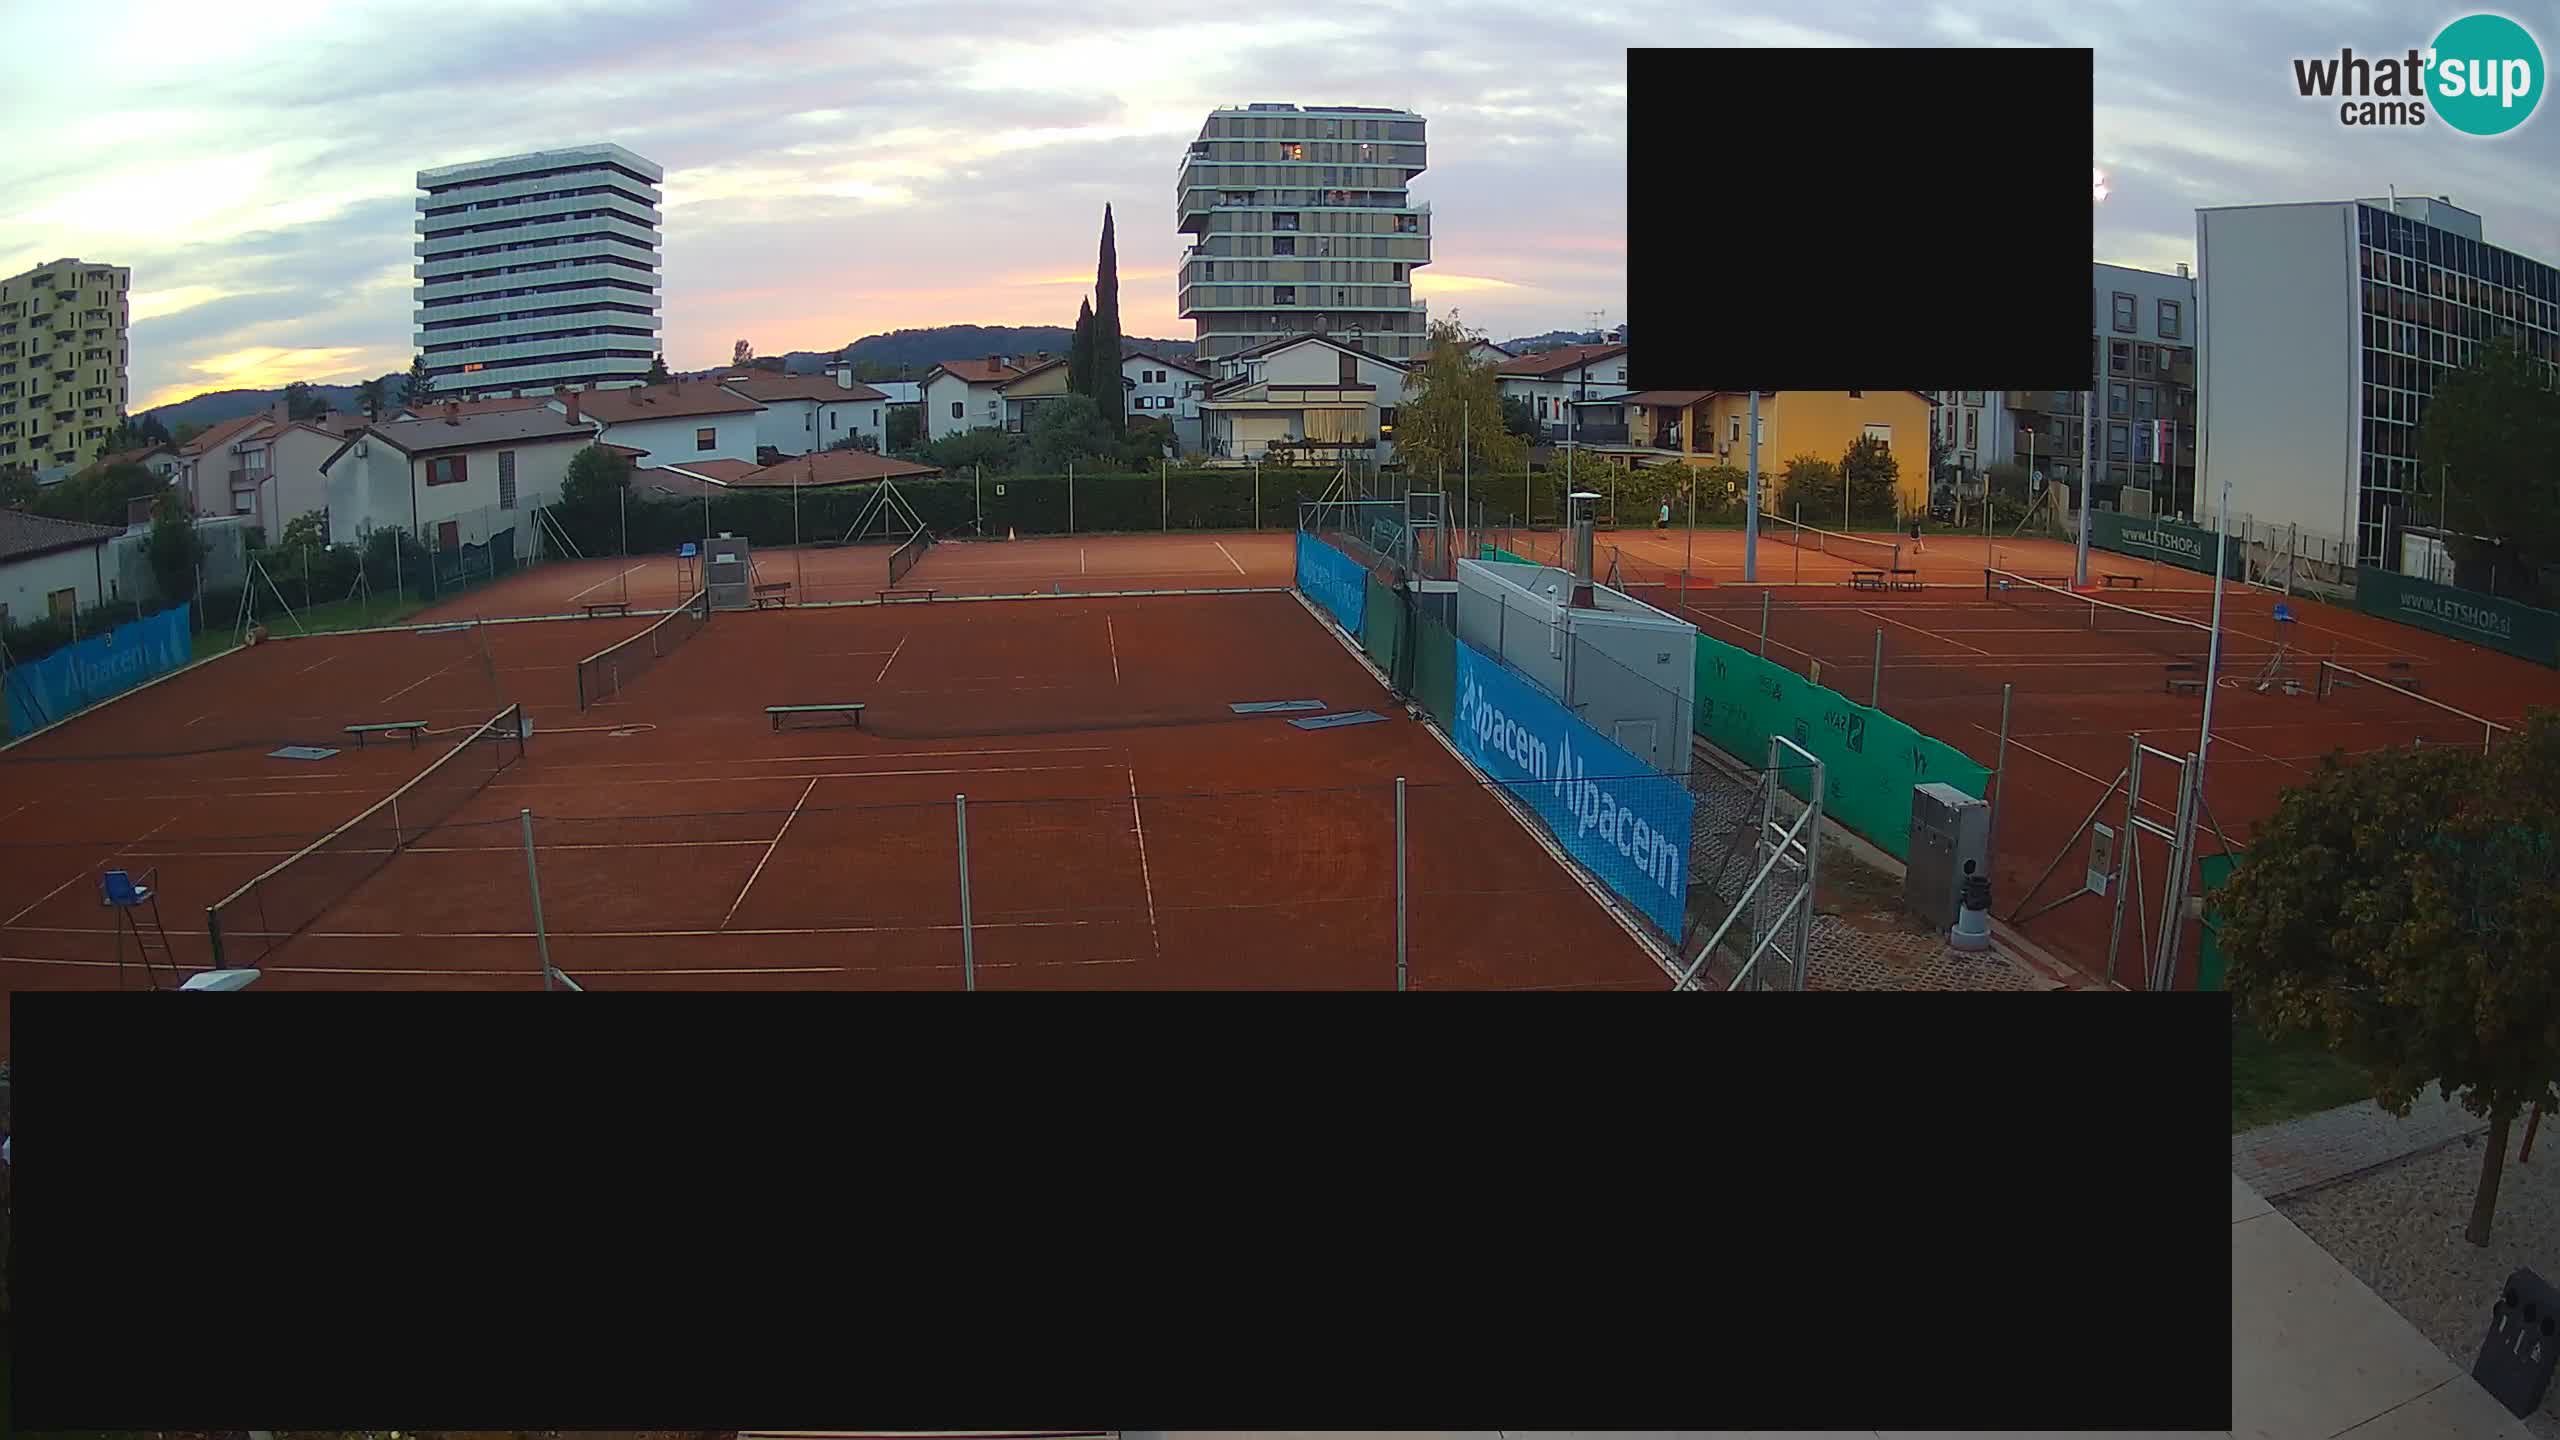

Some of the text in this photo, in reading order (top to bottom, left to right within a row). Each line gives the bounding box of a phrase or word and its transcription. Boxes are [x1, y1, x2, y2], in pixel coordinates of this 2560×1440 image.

[2121, 528, 2201, 556] www.LETSHOP.si
[2400, 593, 2512, 633] www.LETSHOP.si
[1461, 665, 1549, 785] Alpacem
[1554, 727, 1679, 899] Alpacem
